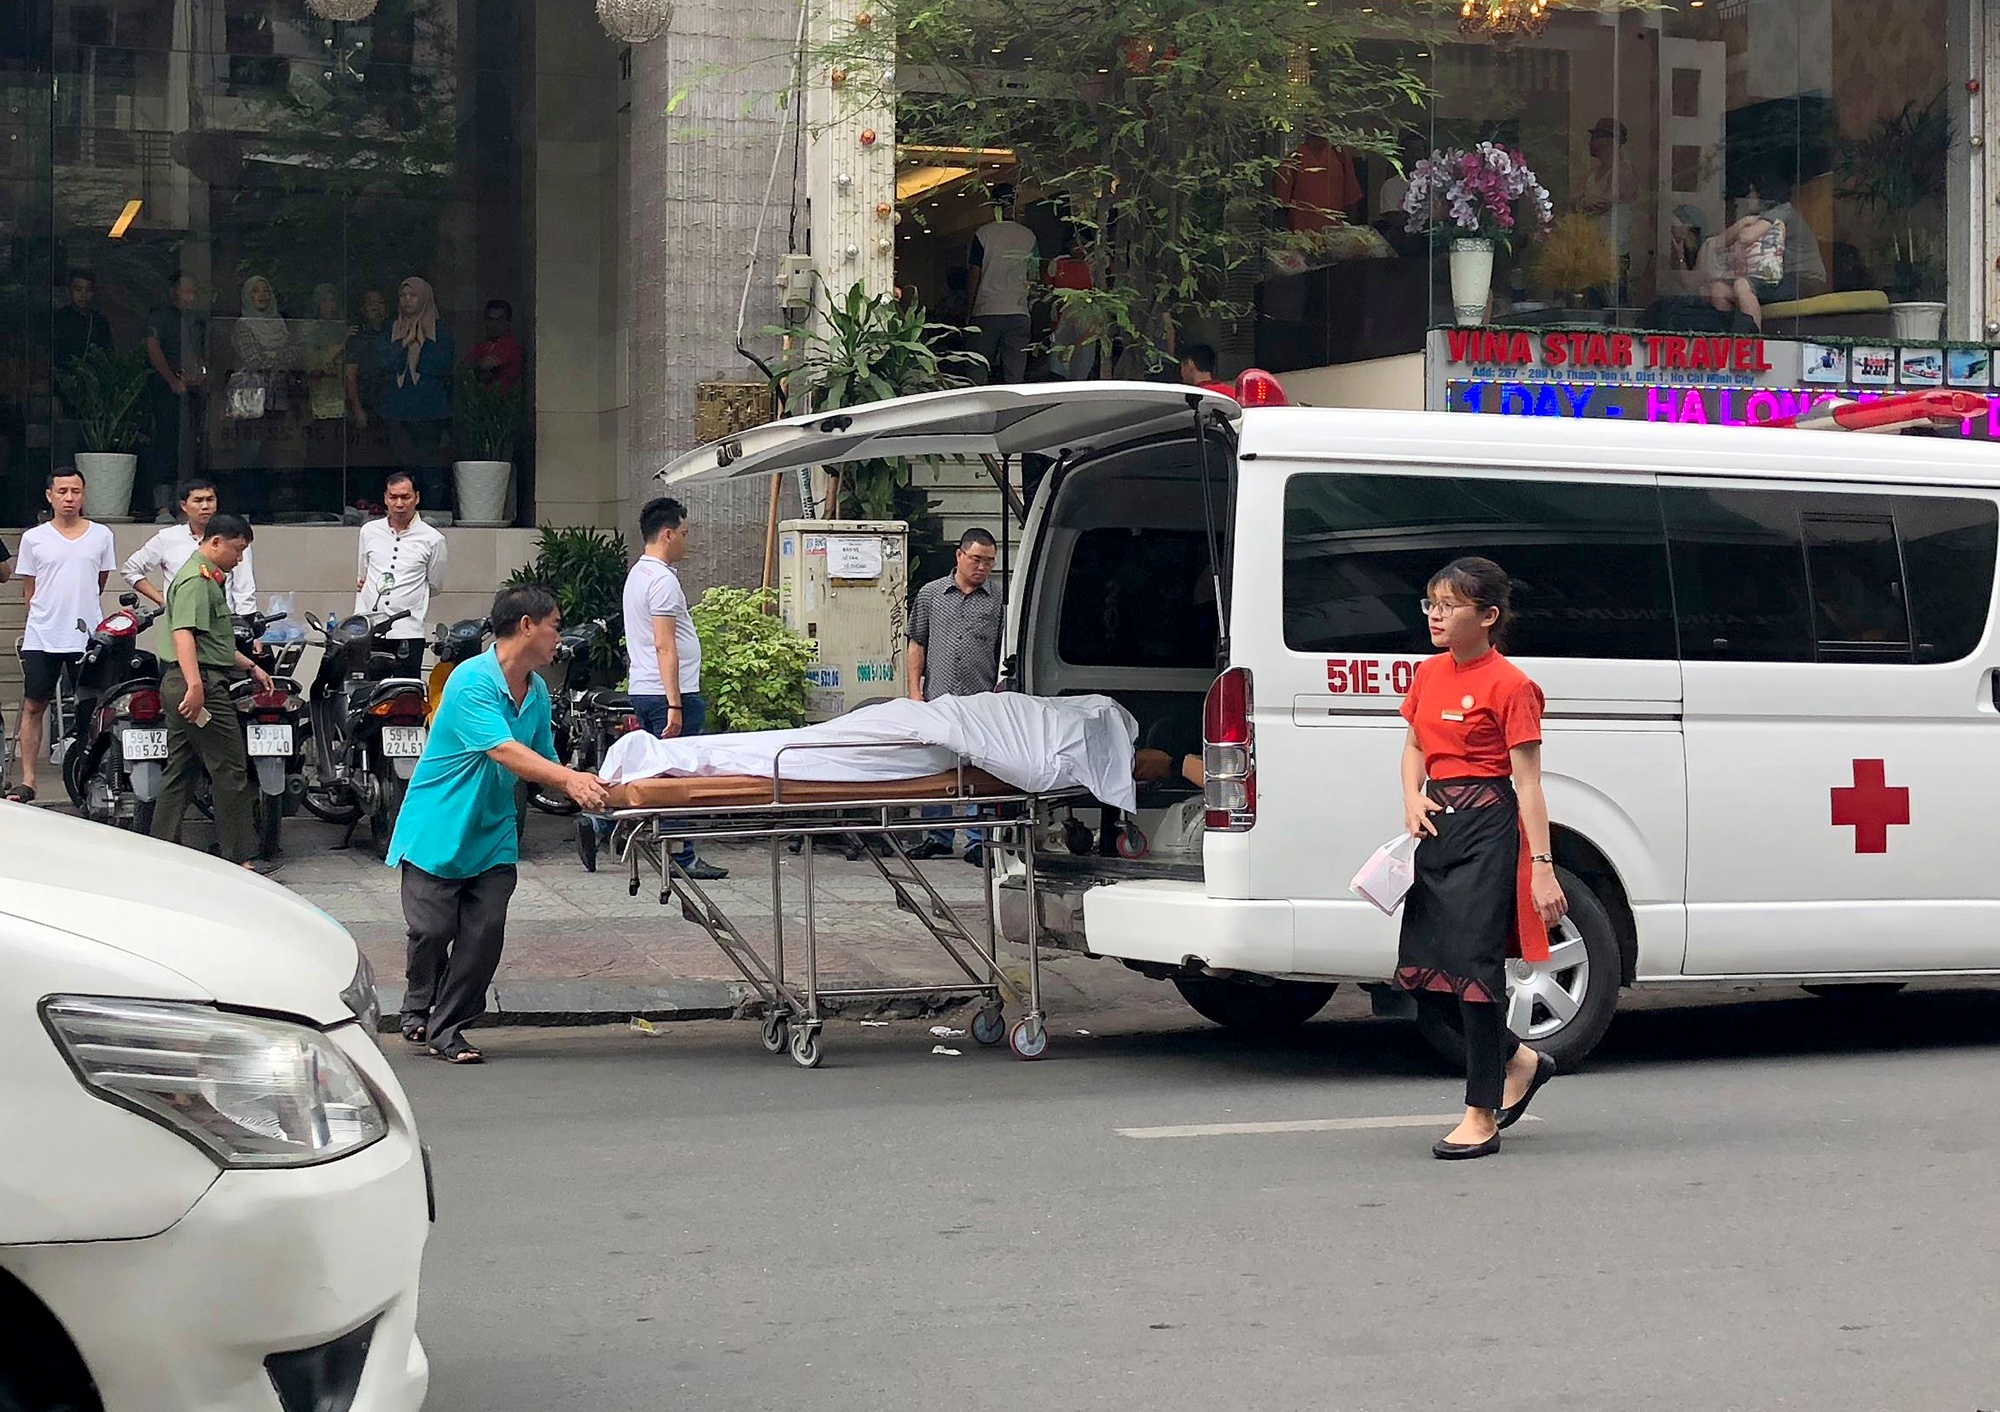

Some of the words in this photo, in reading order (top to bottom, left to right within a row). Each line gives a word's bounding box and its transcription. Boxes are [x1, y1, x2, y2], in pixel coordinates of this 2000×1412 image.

[1447, 330, 1533, 363] VINA
[1545, 331, 1632, 366] STAR
[1645, 335, 1773, 371] TRAVEL
[1472, 366, 1495, 378] Add:
[1671, 372, 1684, 384] Ho
[1687, 372, 1704, 385] Chi
[1735, 374, 1755, 386] City
[1462, 384, 1481, 413] 1
[1501, 385, 1595, 418] DAY
[1648, 388, 1708, 424] HA
[1327, 659, 1423, 694] 51E-0
[130, 731, 162, 744] 59-V2
[390, 729, 418, 741] 59-P1
